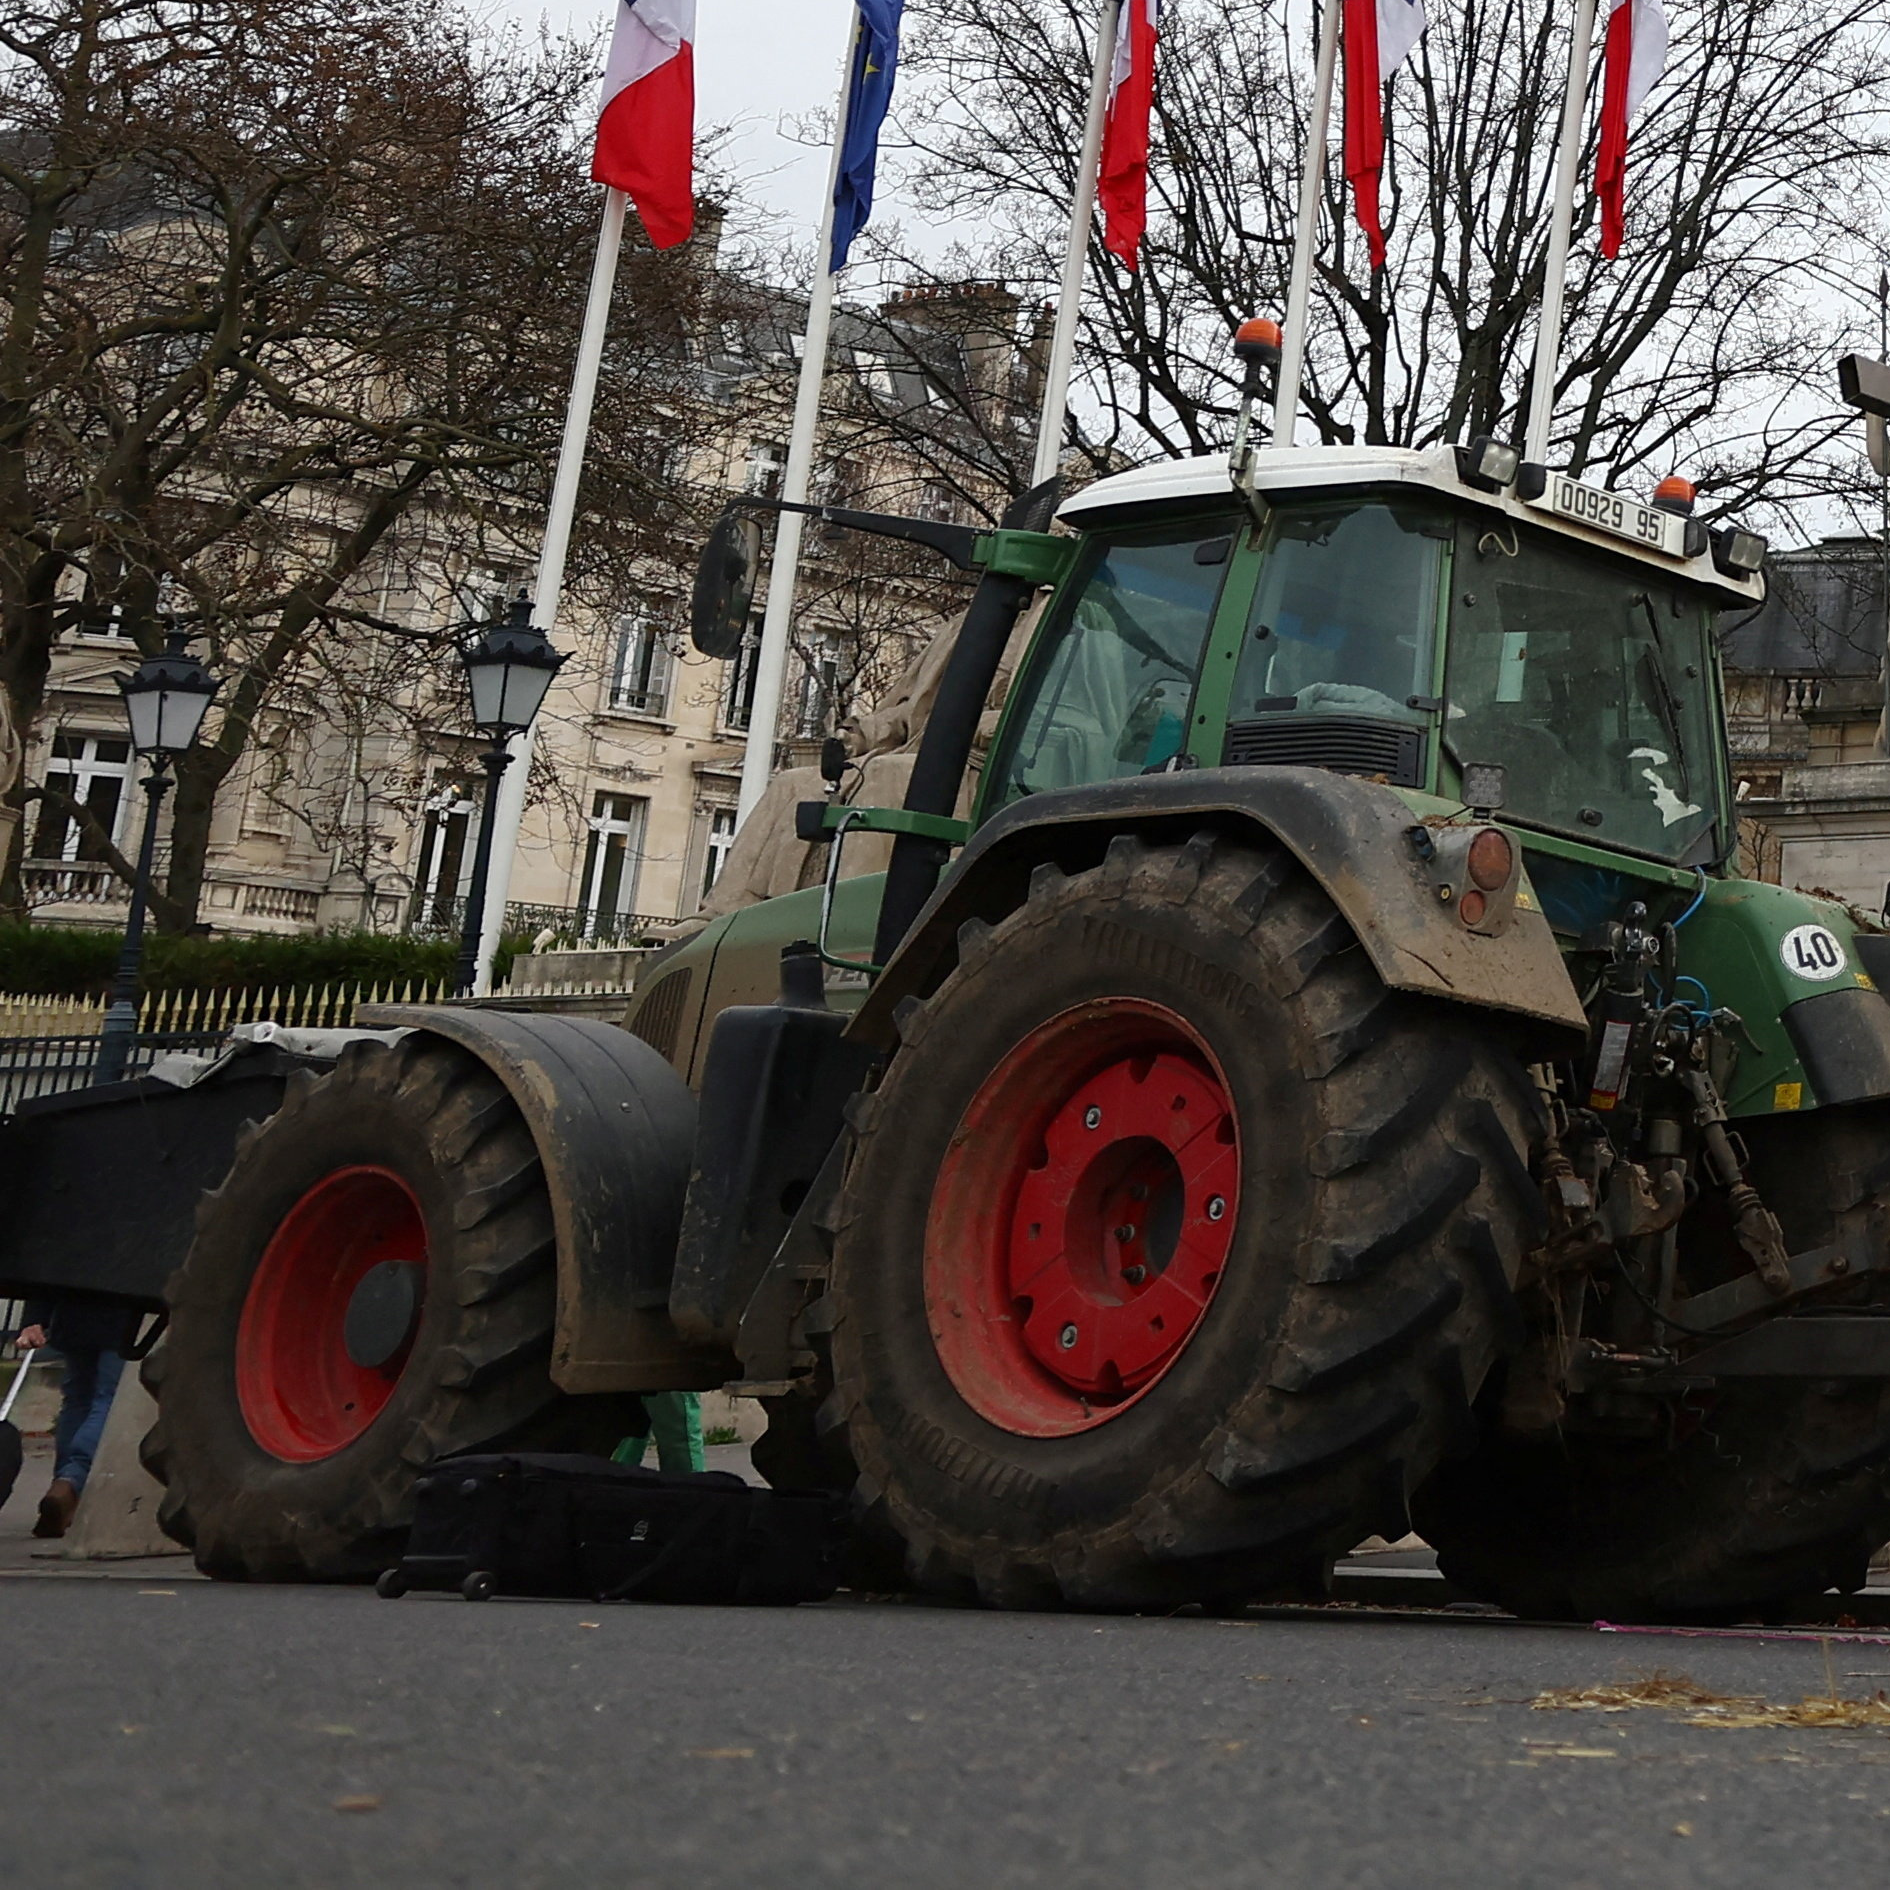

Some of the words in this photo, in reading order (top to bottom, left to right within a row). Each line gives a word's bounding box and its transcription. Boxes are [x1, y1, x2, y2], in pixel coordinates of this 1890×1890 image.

[1562, 483, 1623, 528] 00929
[1637, 510, 1660, 541] 95
[1793, 931, 1838, 971] 40
